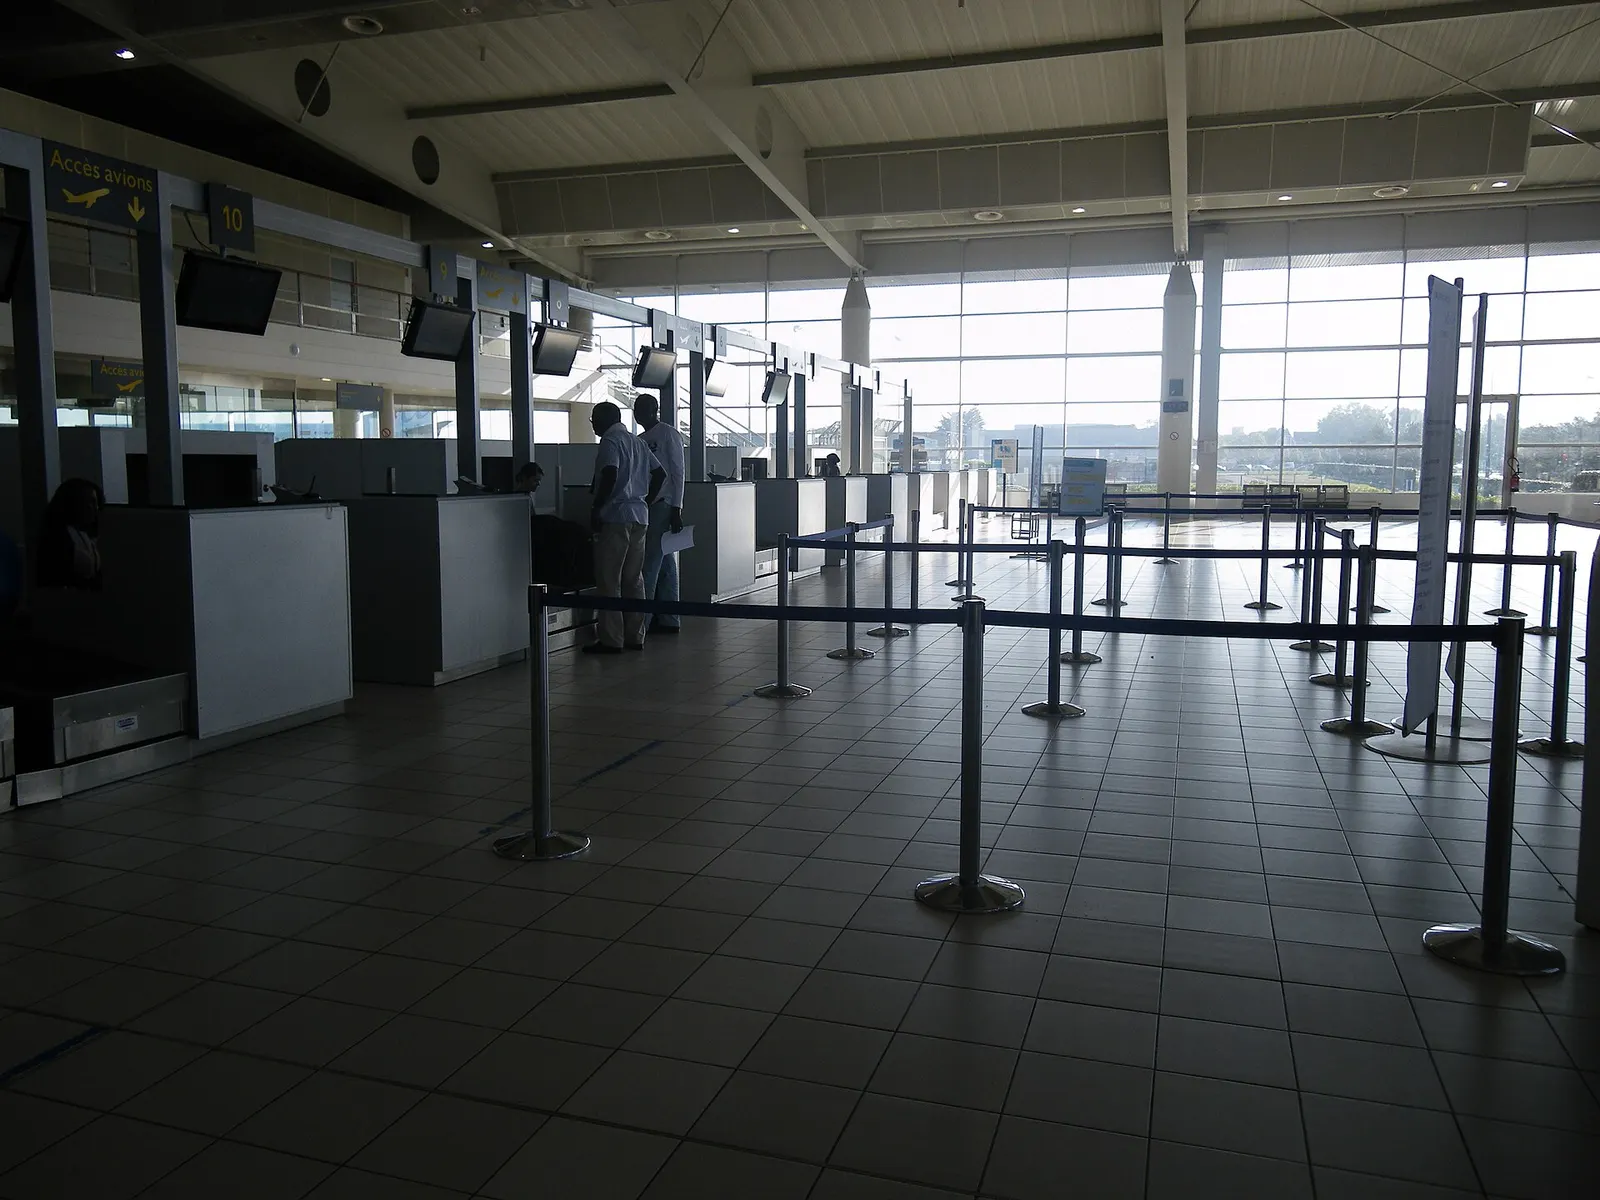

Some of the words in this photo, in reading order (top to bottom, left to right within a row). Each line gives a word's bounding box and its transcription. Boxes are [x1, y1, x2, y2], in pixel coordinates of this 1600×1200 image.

[50, 149, 101, 179] Accès
[105, 168, 153, 193] avions
[221, 204, 243, 232] 10
[440, 260, 448, 281] 9
[100, 363, 128, 377] Accès
